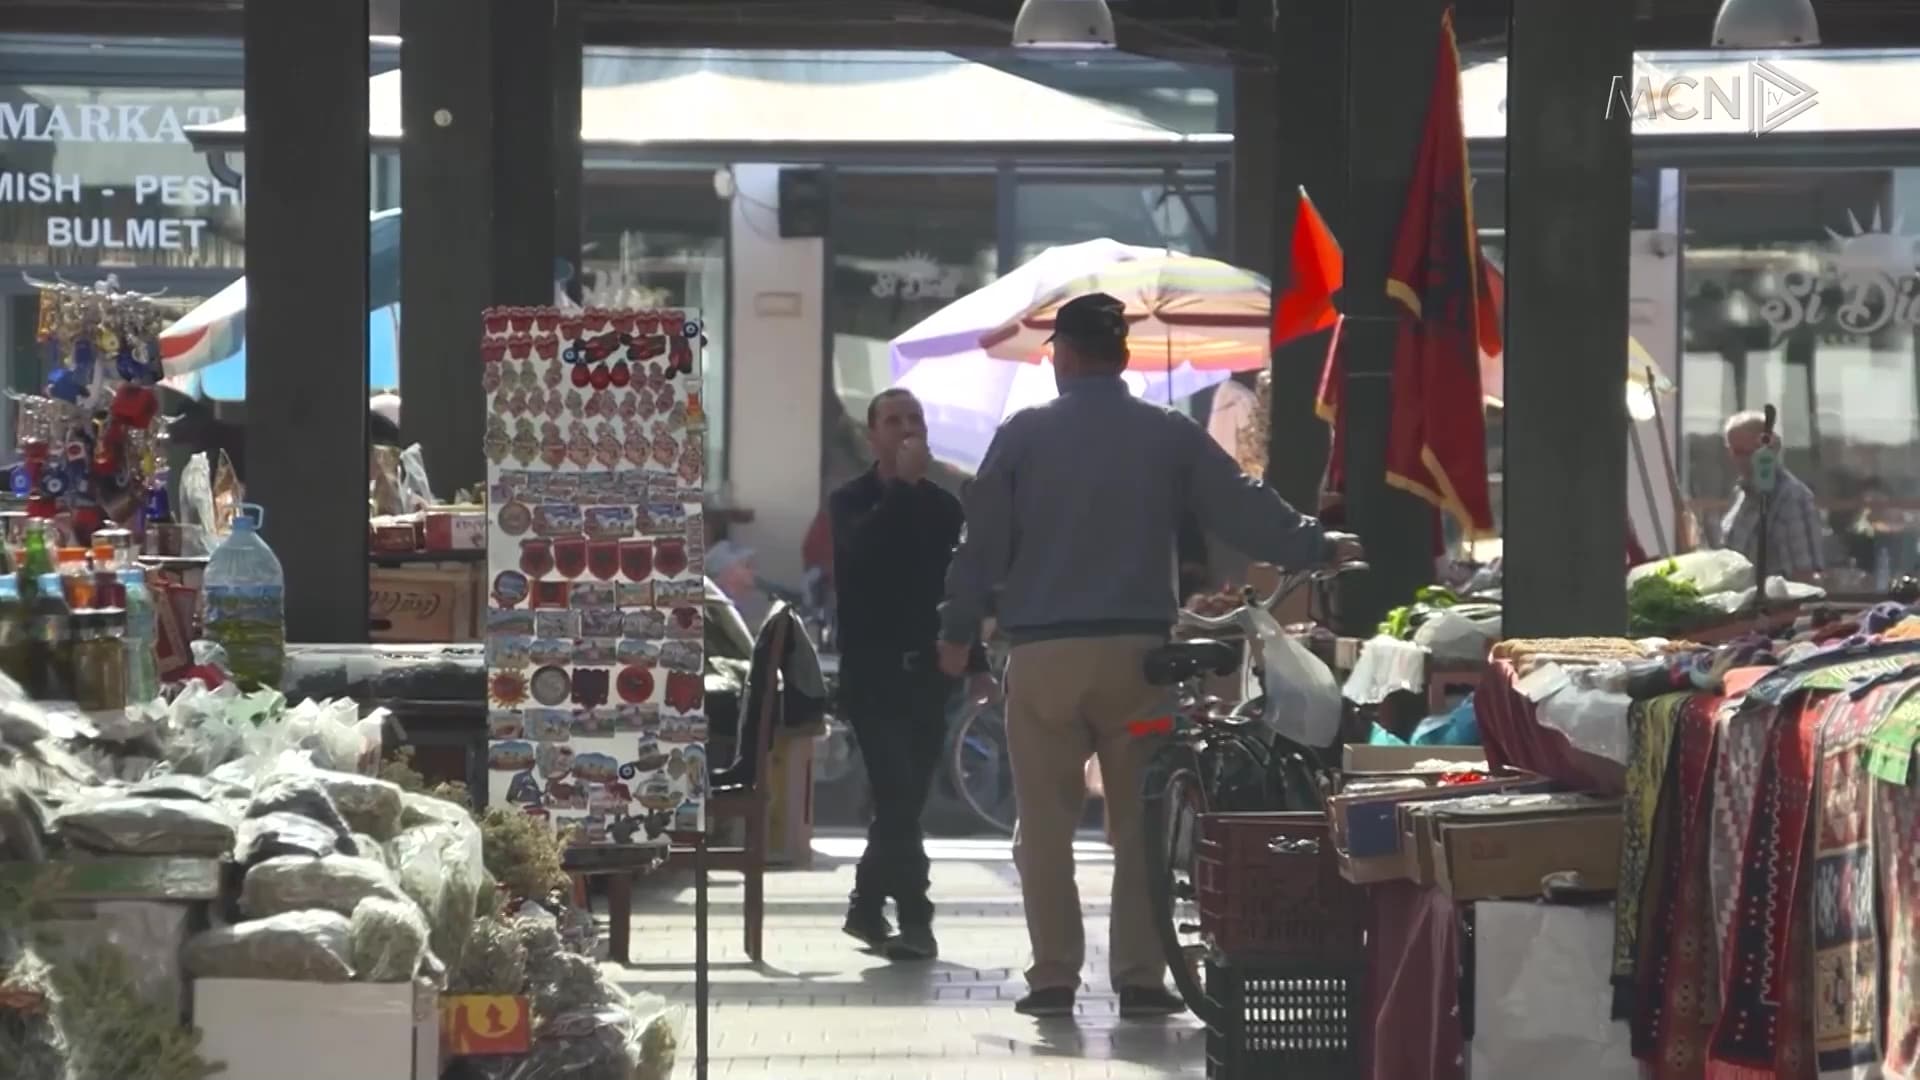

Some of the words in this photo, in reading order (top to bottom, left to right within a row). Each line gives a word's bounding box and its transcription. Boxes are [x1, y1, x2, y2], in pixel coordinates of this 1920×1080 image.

[0, 102, 245, 142] MARKAT
[136, 175, 245, 206] PESH
[48, 216, 207, 248] BULMET
